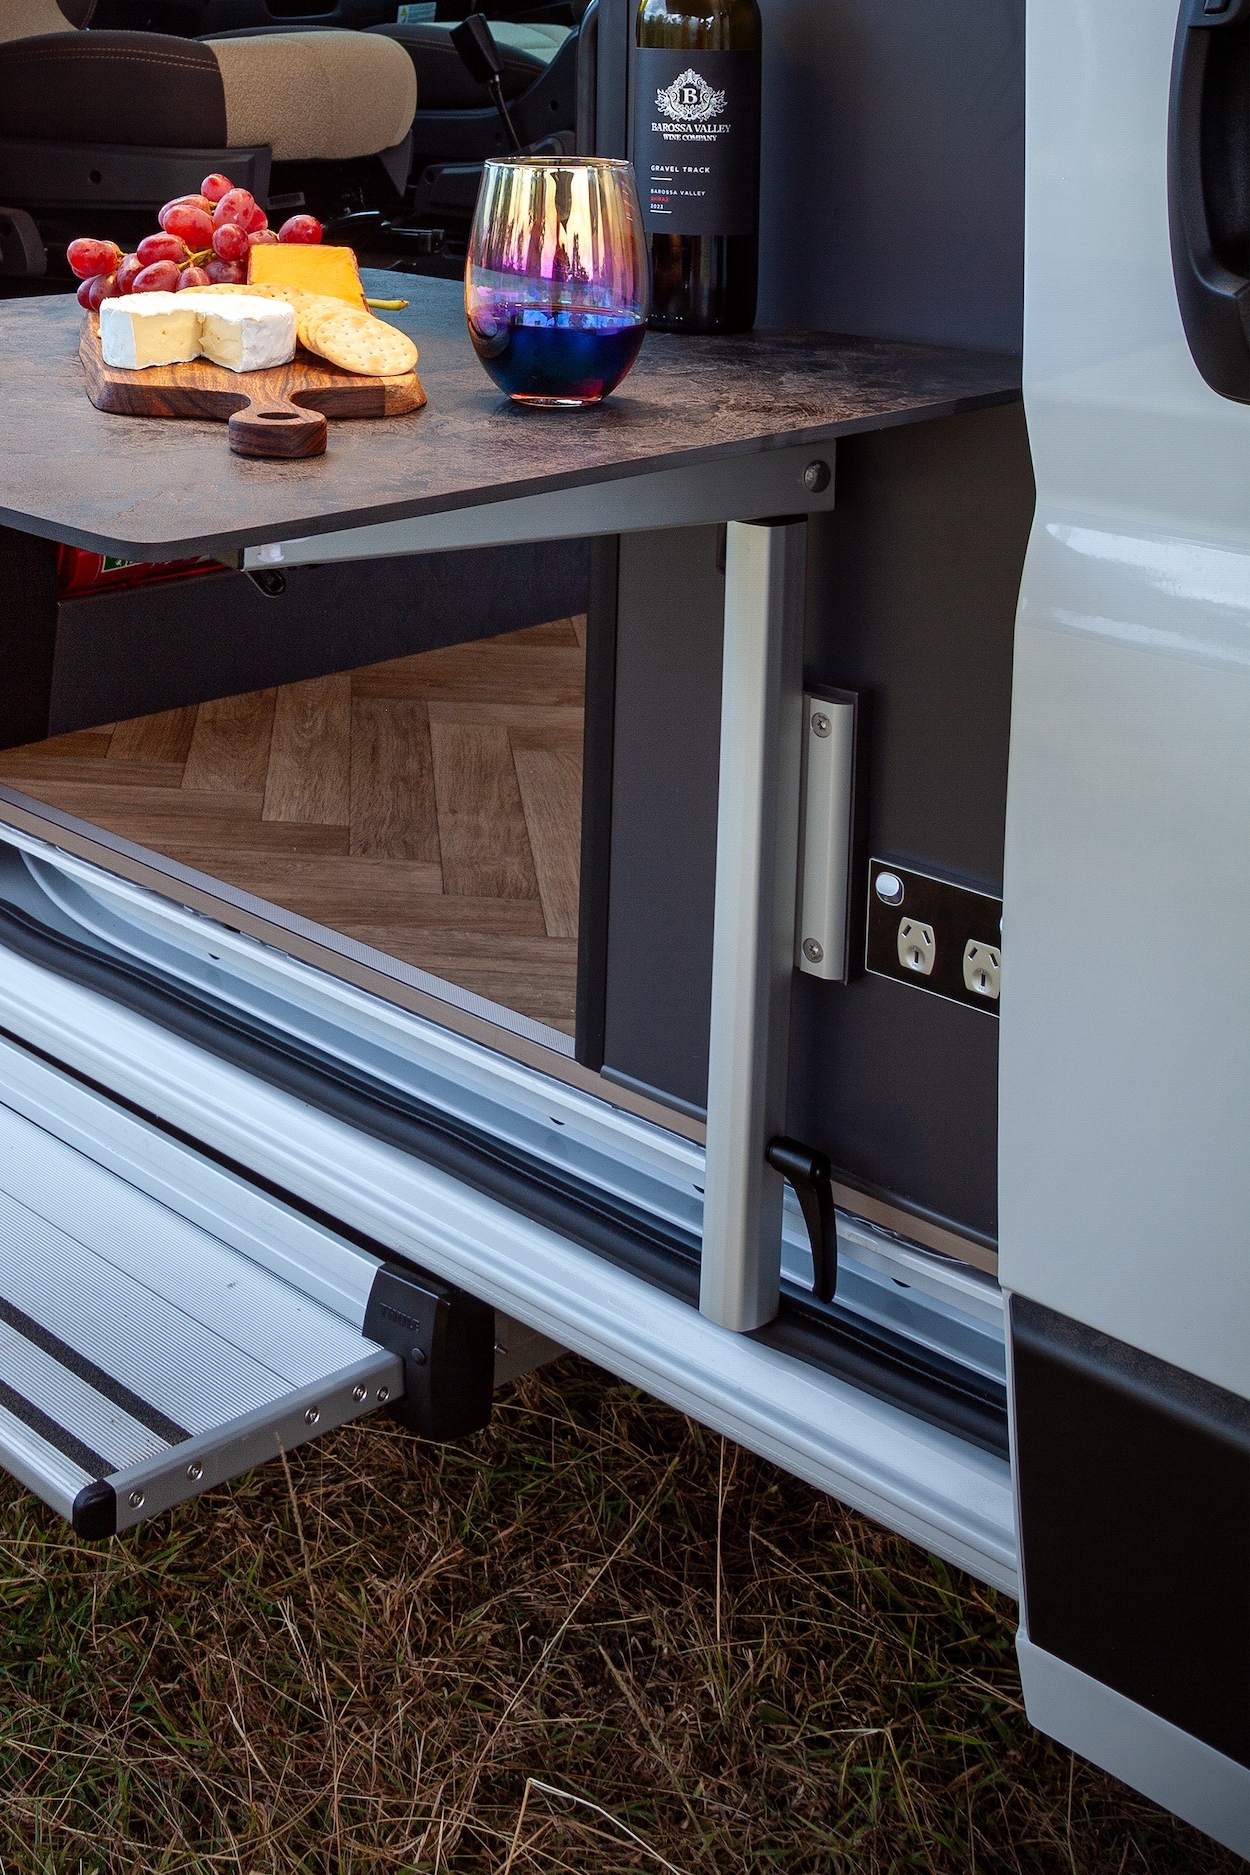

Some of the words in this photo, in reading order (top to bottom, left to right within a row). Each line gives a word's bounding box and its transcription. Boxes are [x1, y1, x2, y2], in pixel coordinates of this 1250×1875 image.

[682, 87, 698, 105] B
[651, 122, 693, 133] BAROSSA
[694, 124, 732, 133] VALLEY
[662, 133, 681, 141] WINE
[682, 134, 717, 142] COMPANY
[650, 165, 680, 173] GRAVEL
[682, 166, 711, 174] TRACK
